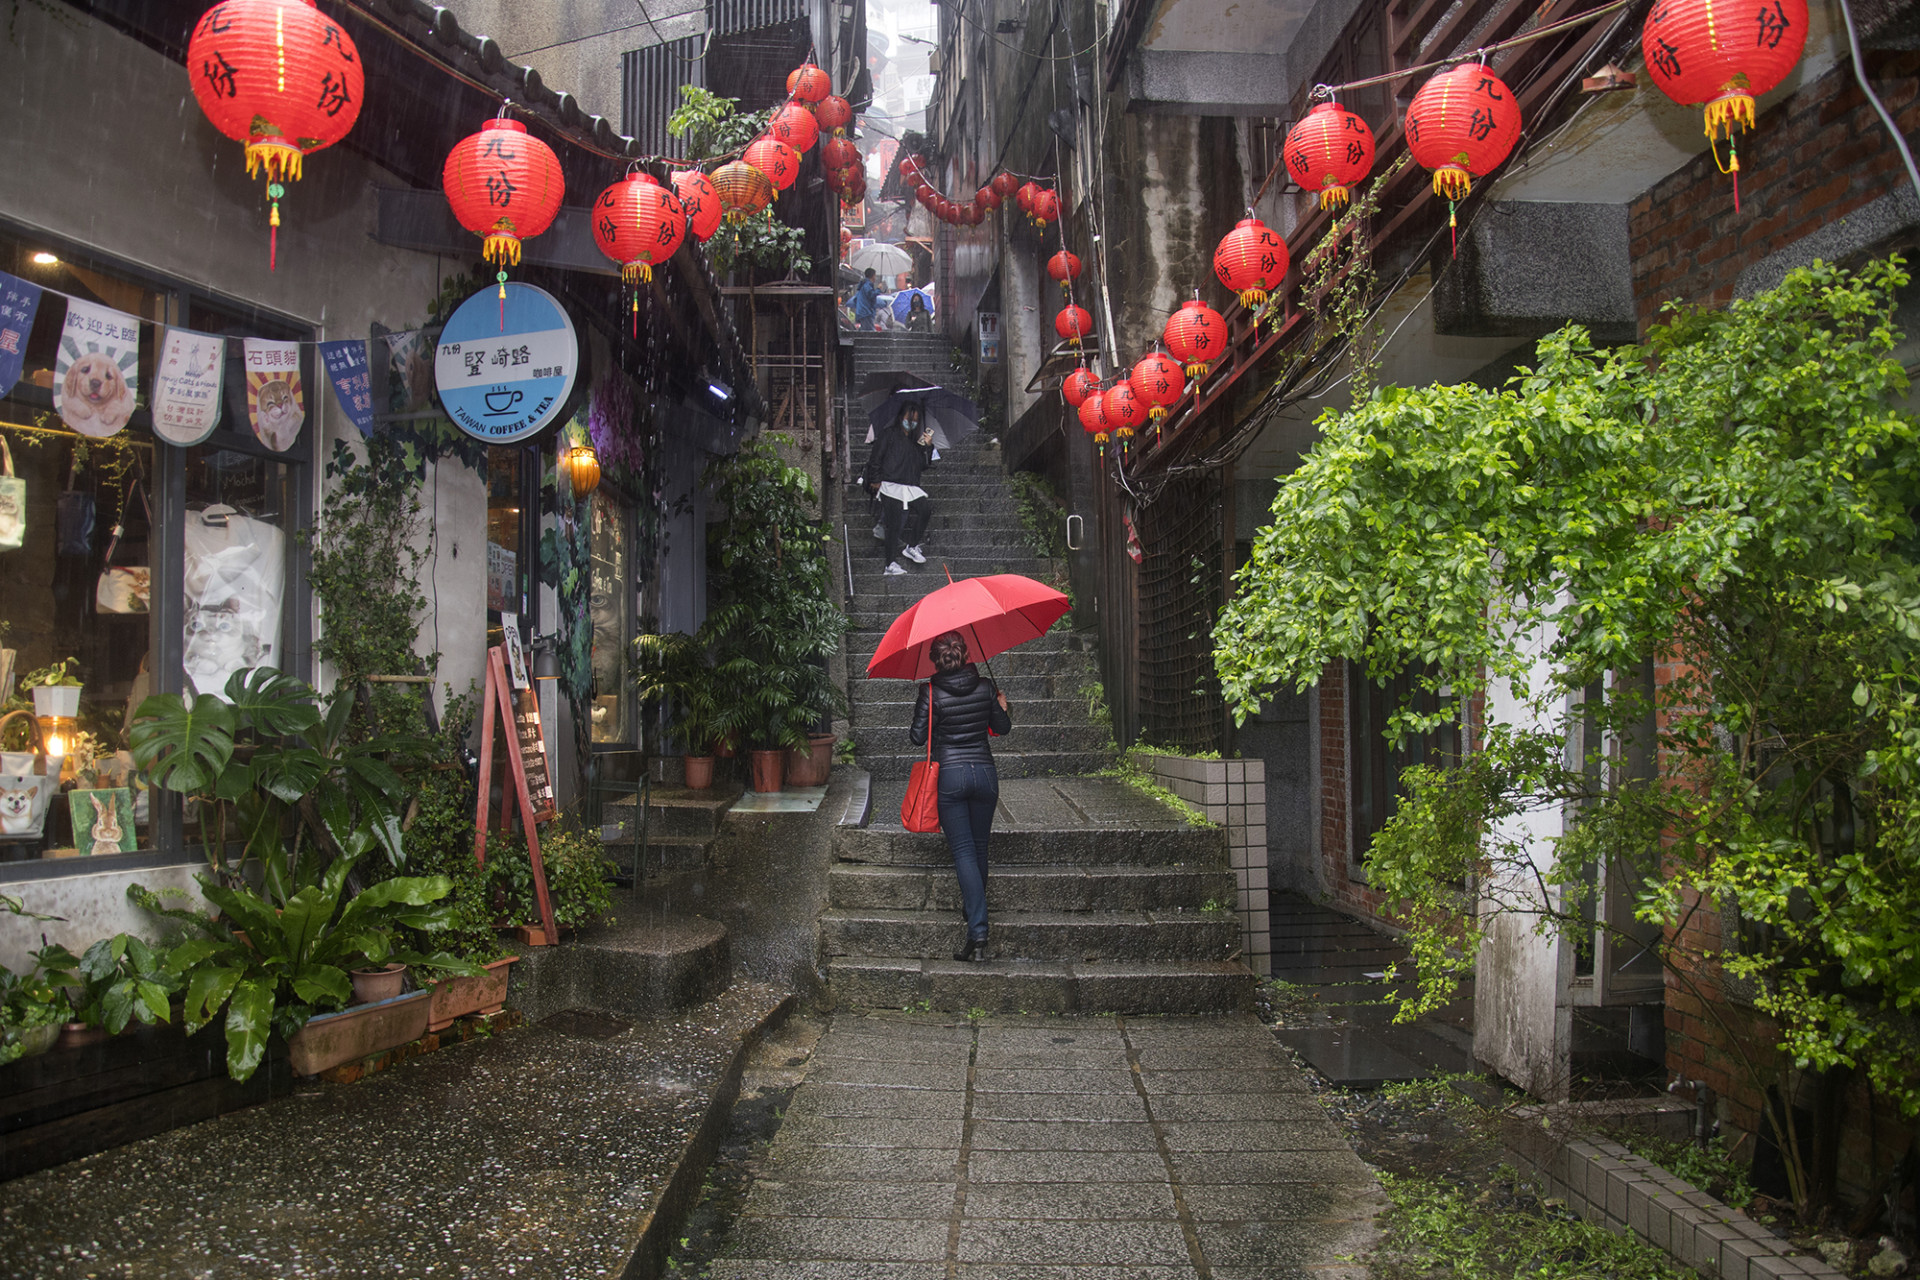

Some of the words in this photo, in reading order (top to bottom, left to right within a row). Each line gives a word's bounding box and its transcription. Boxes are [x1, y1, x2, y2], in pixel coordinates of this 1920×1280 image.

[198, 6, 239, 99] 九份
[317, 25, 354, 117] 九份
[1469, 77, 1502, 141] 九份
[774, 145, 788, 176] 九份
[1289, 126, 1309, 175] 九份
[1345, 116, 1366, 165] 九份
[482, 137, 518, 208] 九份
[597, 189, 619, 243] 九份
[685, 178, 710, 218] 九份
[656, 193, 679, 246] 九份
[1260, 232, 1278, 273] 九份
[67, 311, 137, 343] 歡迎光臨
[1193, 314, 1211, 349] 九份
[247, 350, 297, 366] 石頭貓
[442, 344, 461, 356] 九份
[533, 366, 563, 379] 咖啡屋
[1154, 362, 1170, 394] 九份
[166, 404, 204, 416] 台灣設計
[454, 406, 487, 433] TAIWAN
[489, 419, 527, 435] COFFEE
[528, 415, 537, 424] &
[535, 395, 554, 416] TEA
[1121, 391, 1135, 418] 九份
